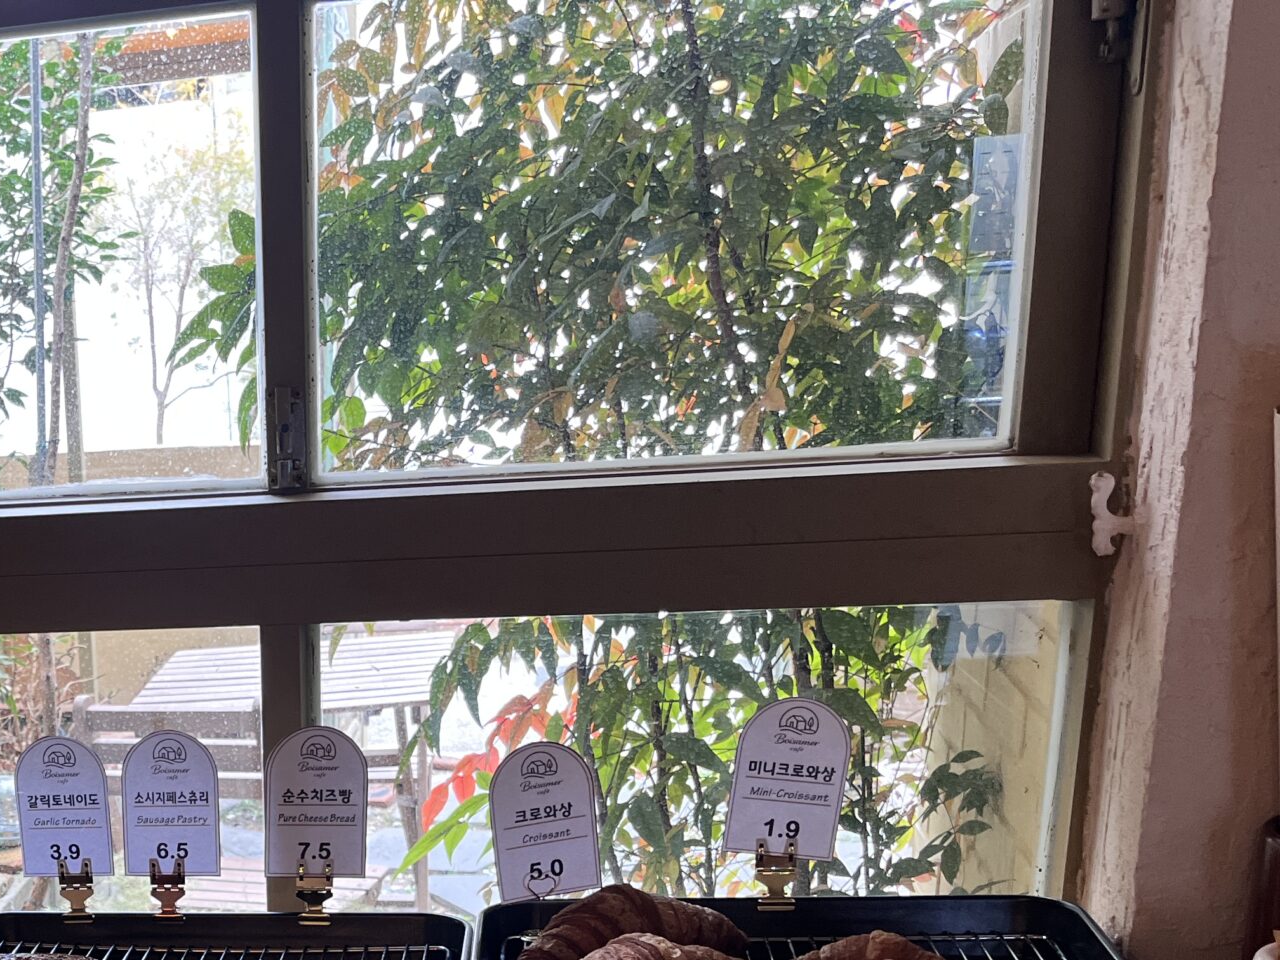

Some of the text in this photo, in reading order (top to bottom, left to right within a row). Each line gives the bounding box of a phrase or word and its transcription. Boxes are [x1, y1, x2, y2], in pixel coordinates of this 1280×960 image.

[748, 760, 836, 783] 미니크로와상
[27, 794, 100, 809] 갈릭토네이도
[134, 790, 209, 804] 소시지페스츄리
[282, 788, 353, 804] 순수치즈빵
[749, 786, 830, 802] Mini-Croissant
[136, 815, 208, 826] Sausage Pastry
[277, 813, 356, 823] Pure Cheese Bread
[514, 802, 573, 823] 크로와상
[33, 817, 97, 826] Garlic Tornado
[763, 818, 800, 839] 1.9
[522, 829, 572, 844] Croissant
[50, 844, 81, 860] 3.9
[156, 842, 189, 859] 6.5
[298, 842, 331, 860] 7.5
[529, 859, 564, 880] 5.0
